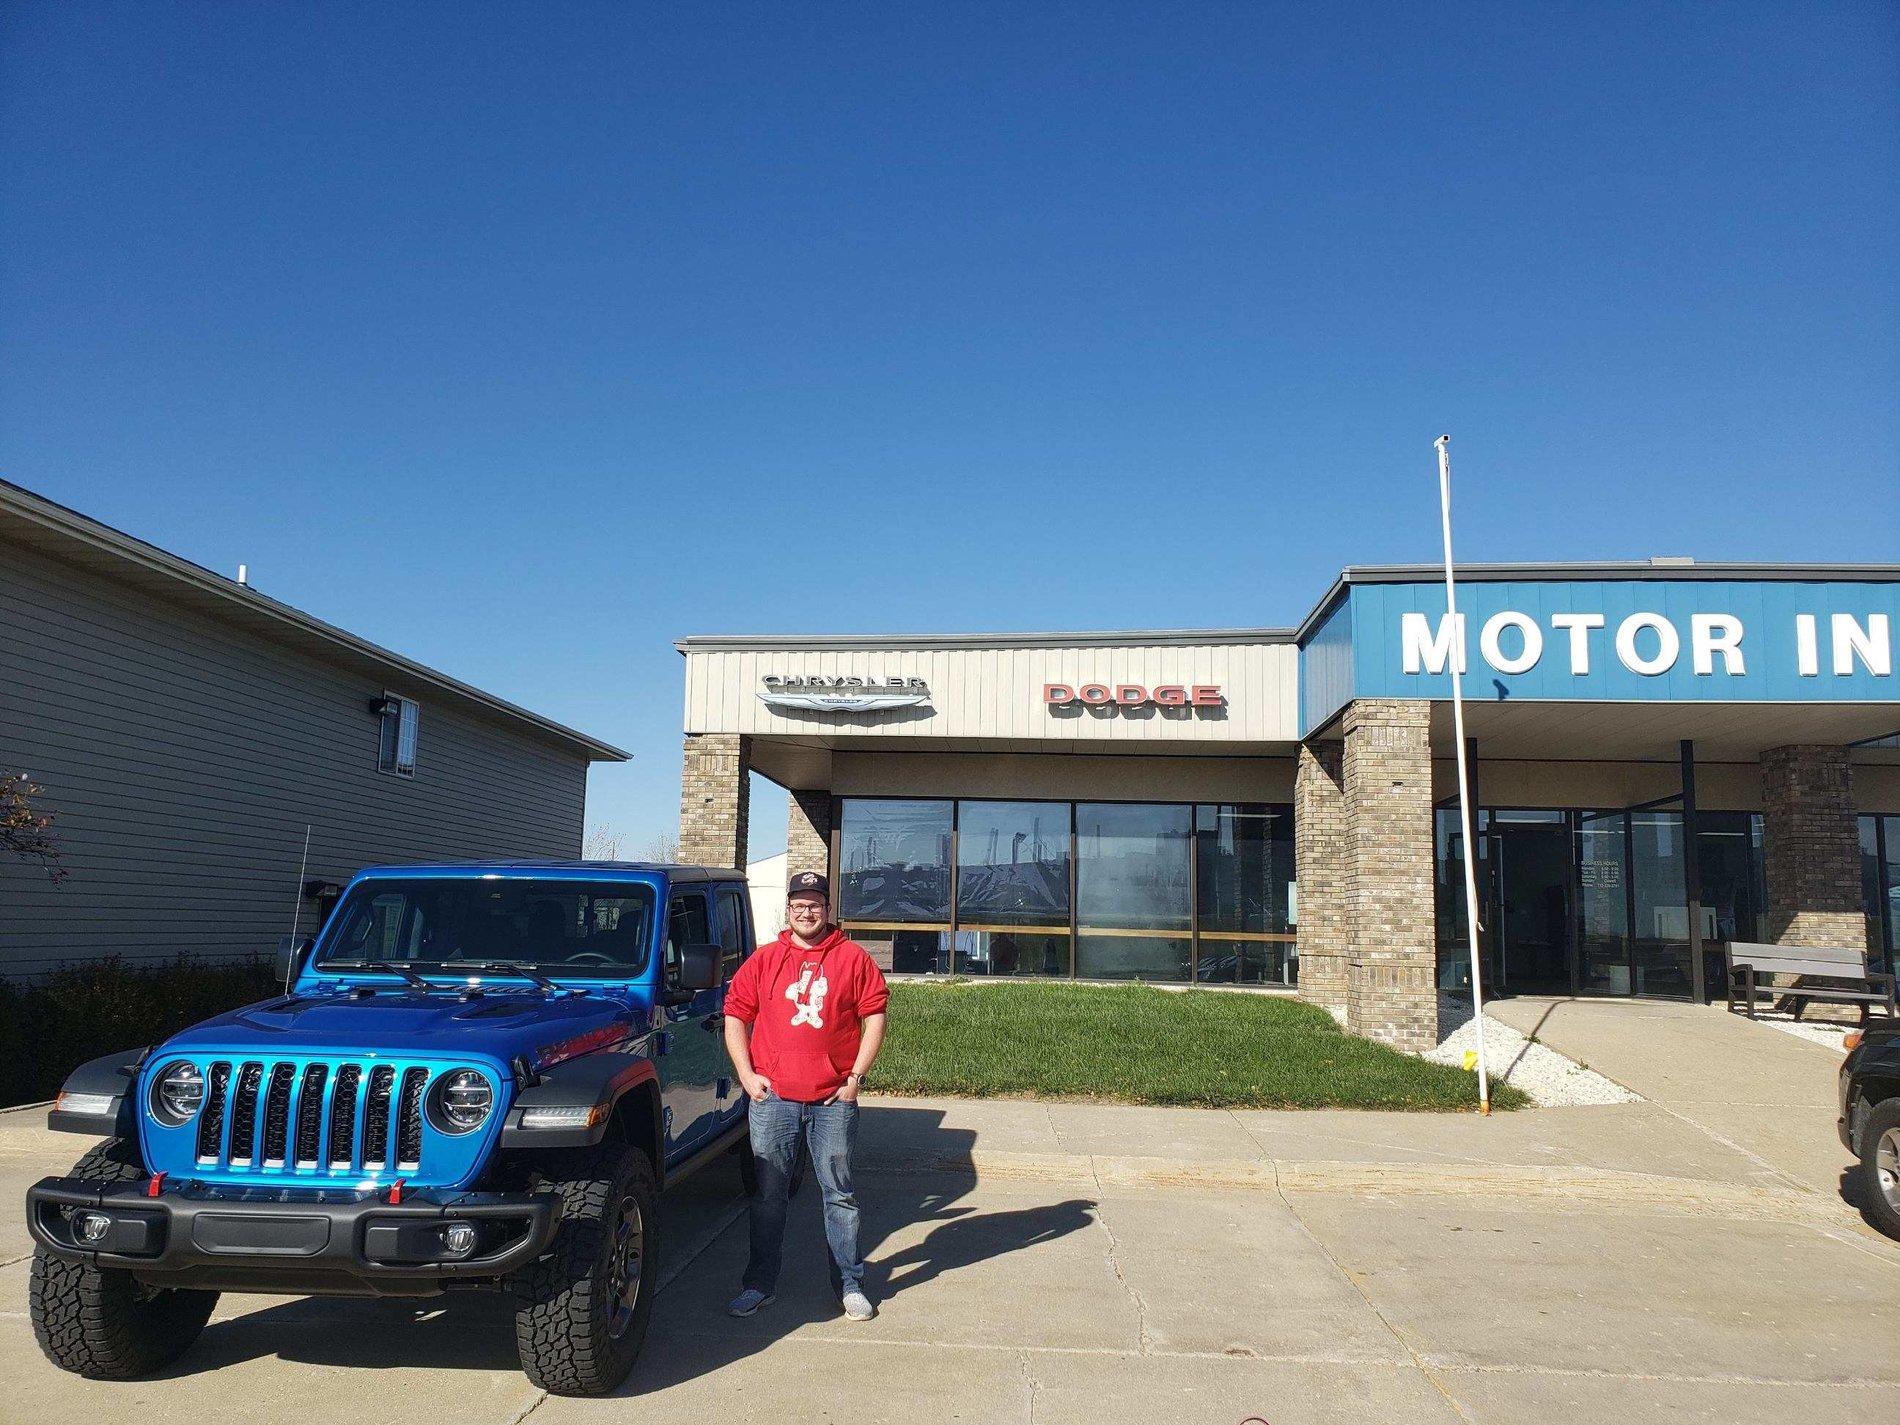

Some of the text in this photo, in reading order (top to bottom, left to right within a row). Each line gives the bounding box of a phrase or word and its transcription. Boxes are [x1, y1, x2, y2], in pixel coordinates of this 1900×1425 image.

[1401, 611, 1891, 678] MOTOR IN
[762, 674, 927, 688] CHRYSLER
[1043, 683, 1222, 705] DODGE
